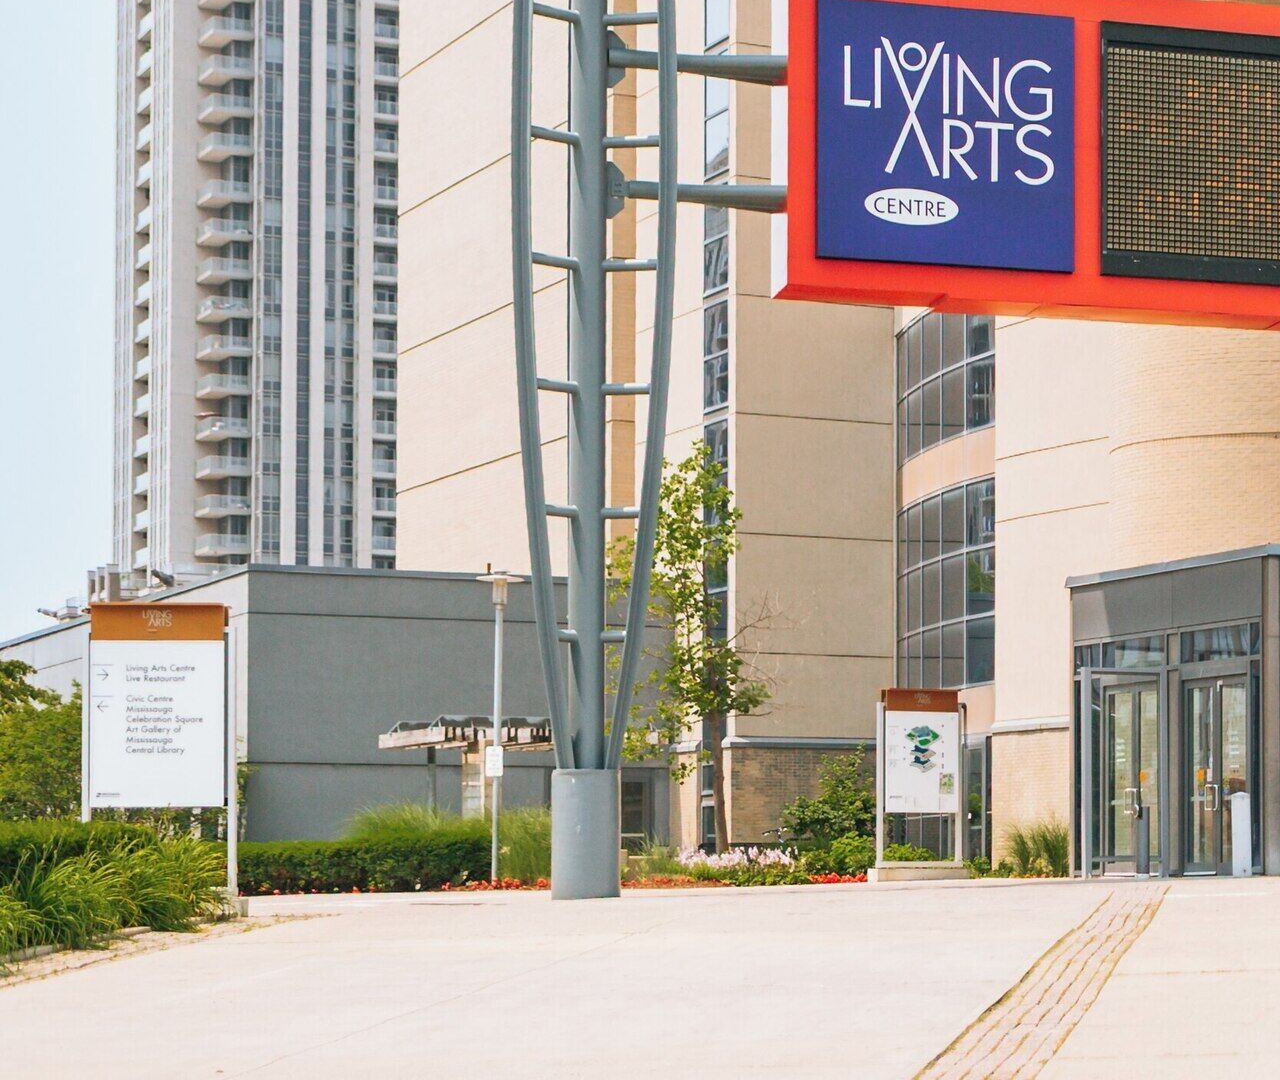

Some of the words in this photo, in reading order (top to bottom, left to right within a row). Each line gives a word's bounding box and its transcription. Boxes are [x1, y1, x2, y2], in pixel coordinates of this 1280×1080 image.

[844, 37, 1052, 121] LIVING
[885, 110, 1054, 186] ARTS
[874, 197, 946, 218] CENTRE
[126, 664, 149, 673] Living
[151, 664, 167, 672] Arts
[170, 664, 196, 672] Centre
[126, 694, 144, 702] Civic
[147, 694, 174, 702] Centre
[126, 706, 173, 715] Mississauga
[126, 715, 172, 723] Celebration
[175, 715, 204, 725] Square
[126, 725, 138, 733] Art
[141, 725, 170, 734] Gallery
[173, 725, 182, 733] of
[126, 736, 173, 745] Mississauga
[126, 745, 154, 754] Central
[157, 745, 185, 756] Library
